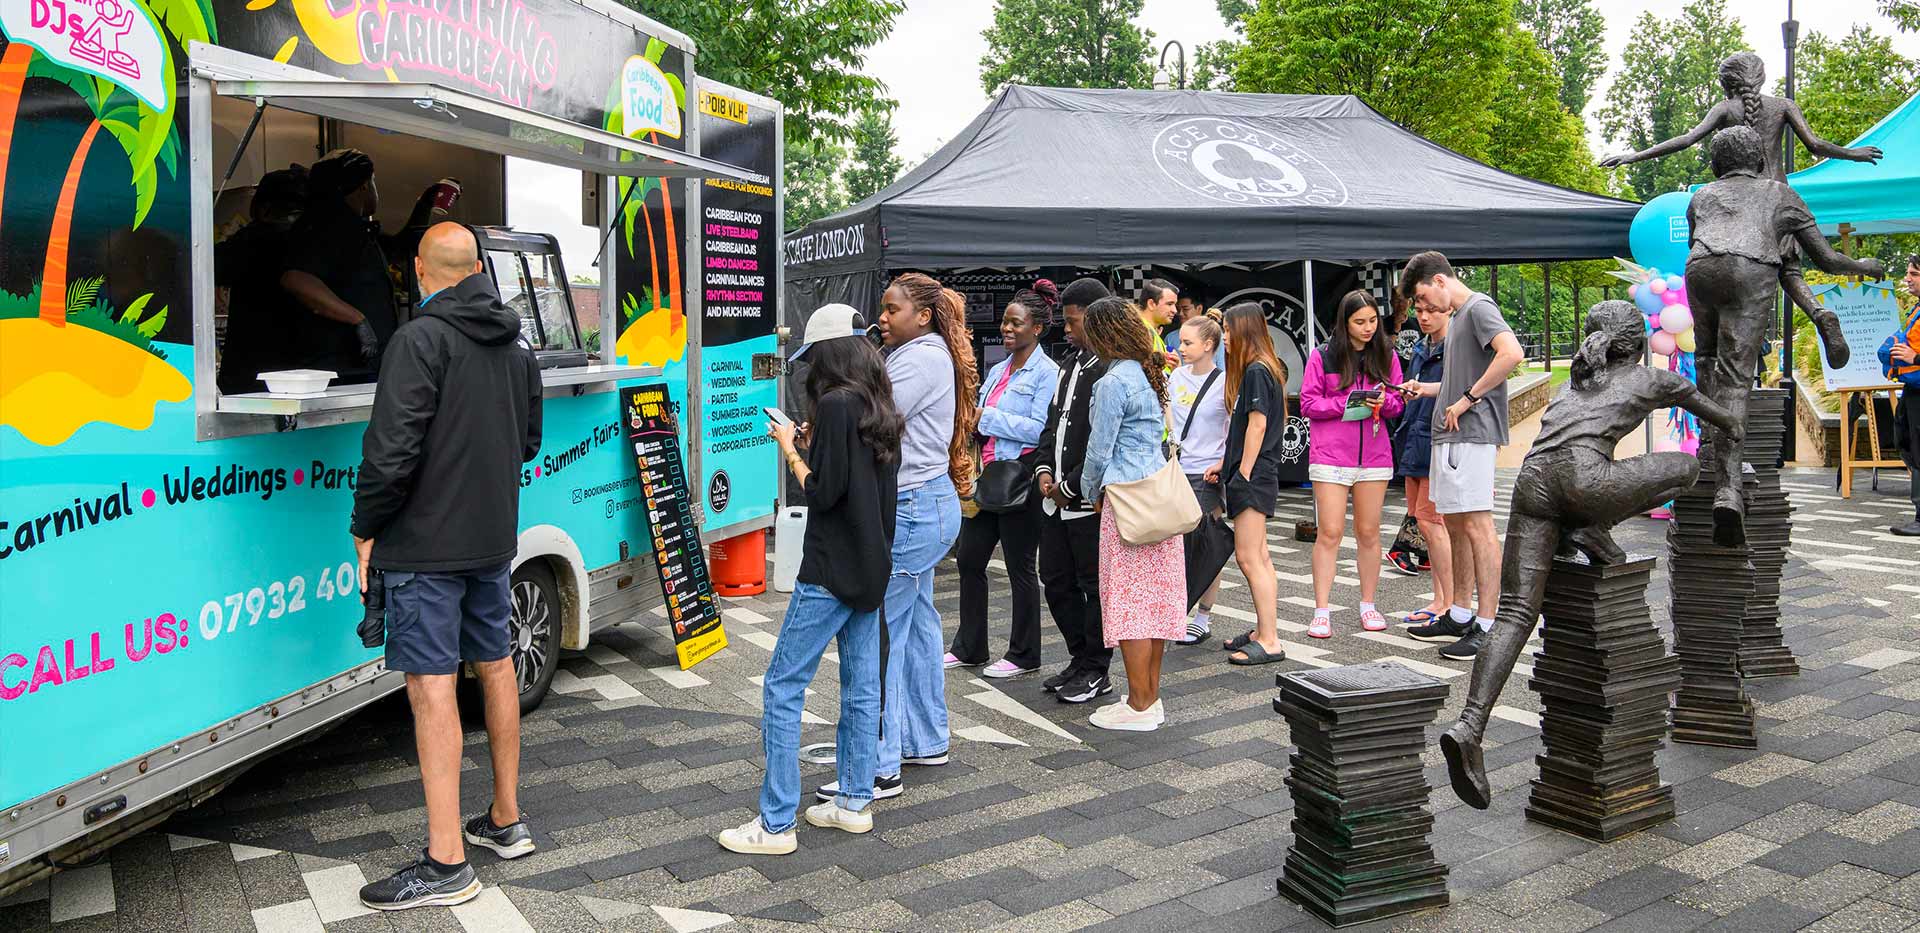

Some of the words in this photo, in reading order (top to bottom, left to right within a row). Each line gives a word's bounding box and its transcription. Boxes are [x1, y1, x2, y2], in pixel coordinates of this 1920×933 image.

[31, 0, 85, 41] DJs
[358, 9, 533, 108] CARIBBEAN
[627, 68, 662, 95] Caribbean
[630, 87, 662, 125] Food
[728, 102, 744, 120] VLH
[1164, 125, 1208, 163] ACE
[1216, 125, 1308, 165] CAFE
[746, 184, 773, 197] BOOKINGS
[1200, 183, 1339, 206] LONDON
[1236, 182, 1299, 194] ACE
[705, 207, 743, 222] CARIBBEAN
[744, 212, 762, 225] FOOD
[705, 223, 721, 237] LIVE
[721, 225, 759, 240] STEELBAND
[705, 240, 743, 254] CARIBBEAN
[744, 244, 757, 255] DJS
[787, 235, 814, 265] CAFE
[815, 224, 865, 260] LONDON
[706, 256, 727, 268] LIMBO
[727, 258, 758, 271] DANCERS
[706, 273, 739, 286] CARNIVAL
[739, 274, 765, 287] DANCES
[952, 284, 986, 292] Temporary
[987, 283, 1015, 291] building
[706, 289, 735, 301] RHYTHM
[735, 290, 763, 302] SECTION
[706, 306, 721, 317] AND
[722, 306, 742, 317] MUCH
[743, 306, 761, 317] MORE
[711, 360, 743, 373] CARNIVAL
[711, 376, 746, 388] WEDDINGS
[711, 393, 738, 405] PARTIES
[711, 409, 739, 422] SUMMER
[740, 406, 758, 418] FAIRS
[711, 422, 753, 437] WORKSHOPS
[544, 436, 591, 477] Summer
[593, 421, 620, 448] Fairs
[711, 438, 751, 454] CORPORATE
[0, 482, 132, 560] Carnival
[163, 463, 287, 501] Weddings
[0, 632, 115, 701] CALL
[124, 612, 189, 662] US:
[199, 575, 306, 640] 07932
